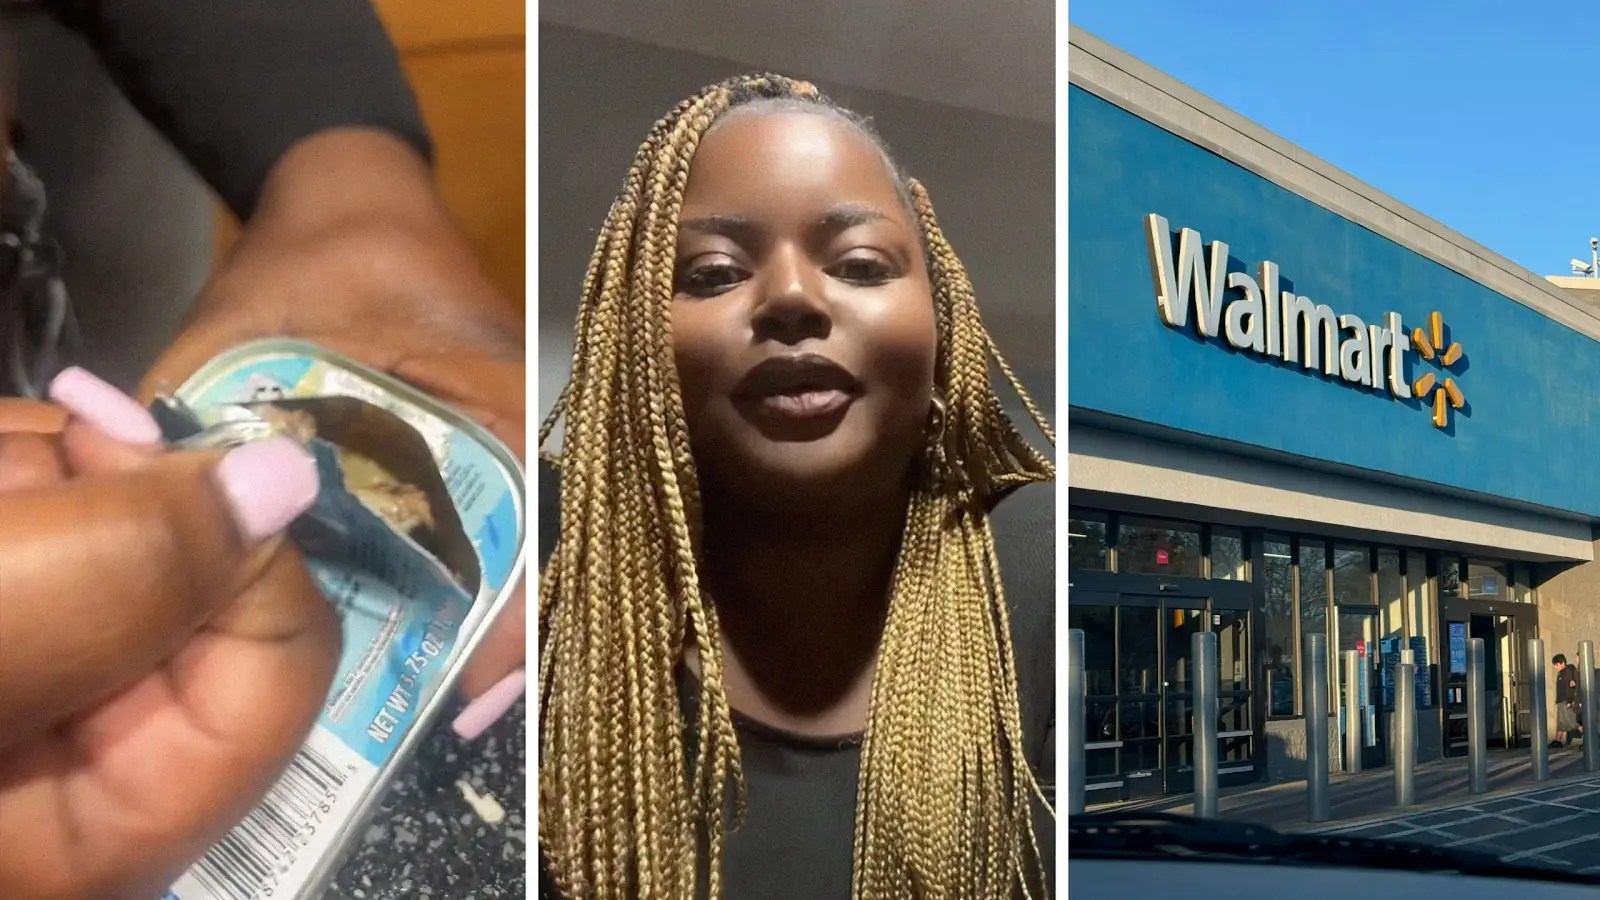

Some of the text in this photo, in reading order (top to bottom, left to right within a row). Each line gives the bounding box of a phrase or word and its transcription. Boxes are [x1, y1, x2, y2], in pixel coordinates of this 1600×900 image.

[1145, 212, 1411, 398] Walmart
[366, 707, 398, 743] NET
[385, 684, 412, 713] WT
